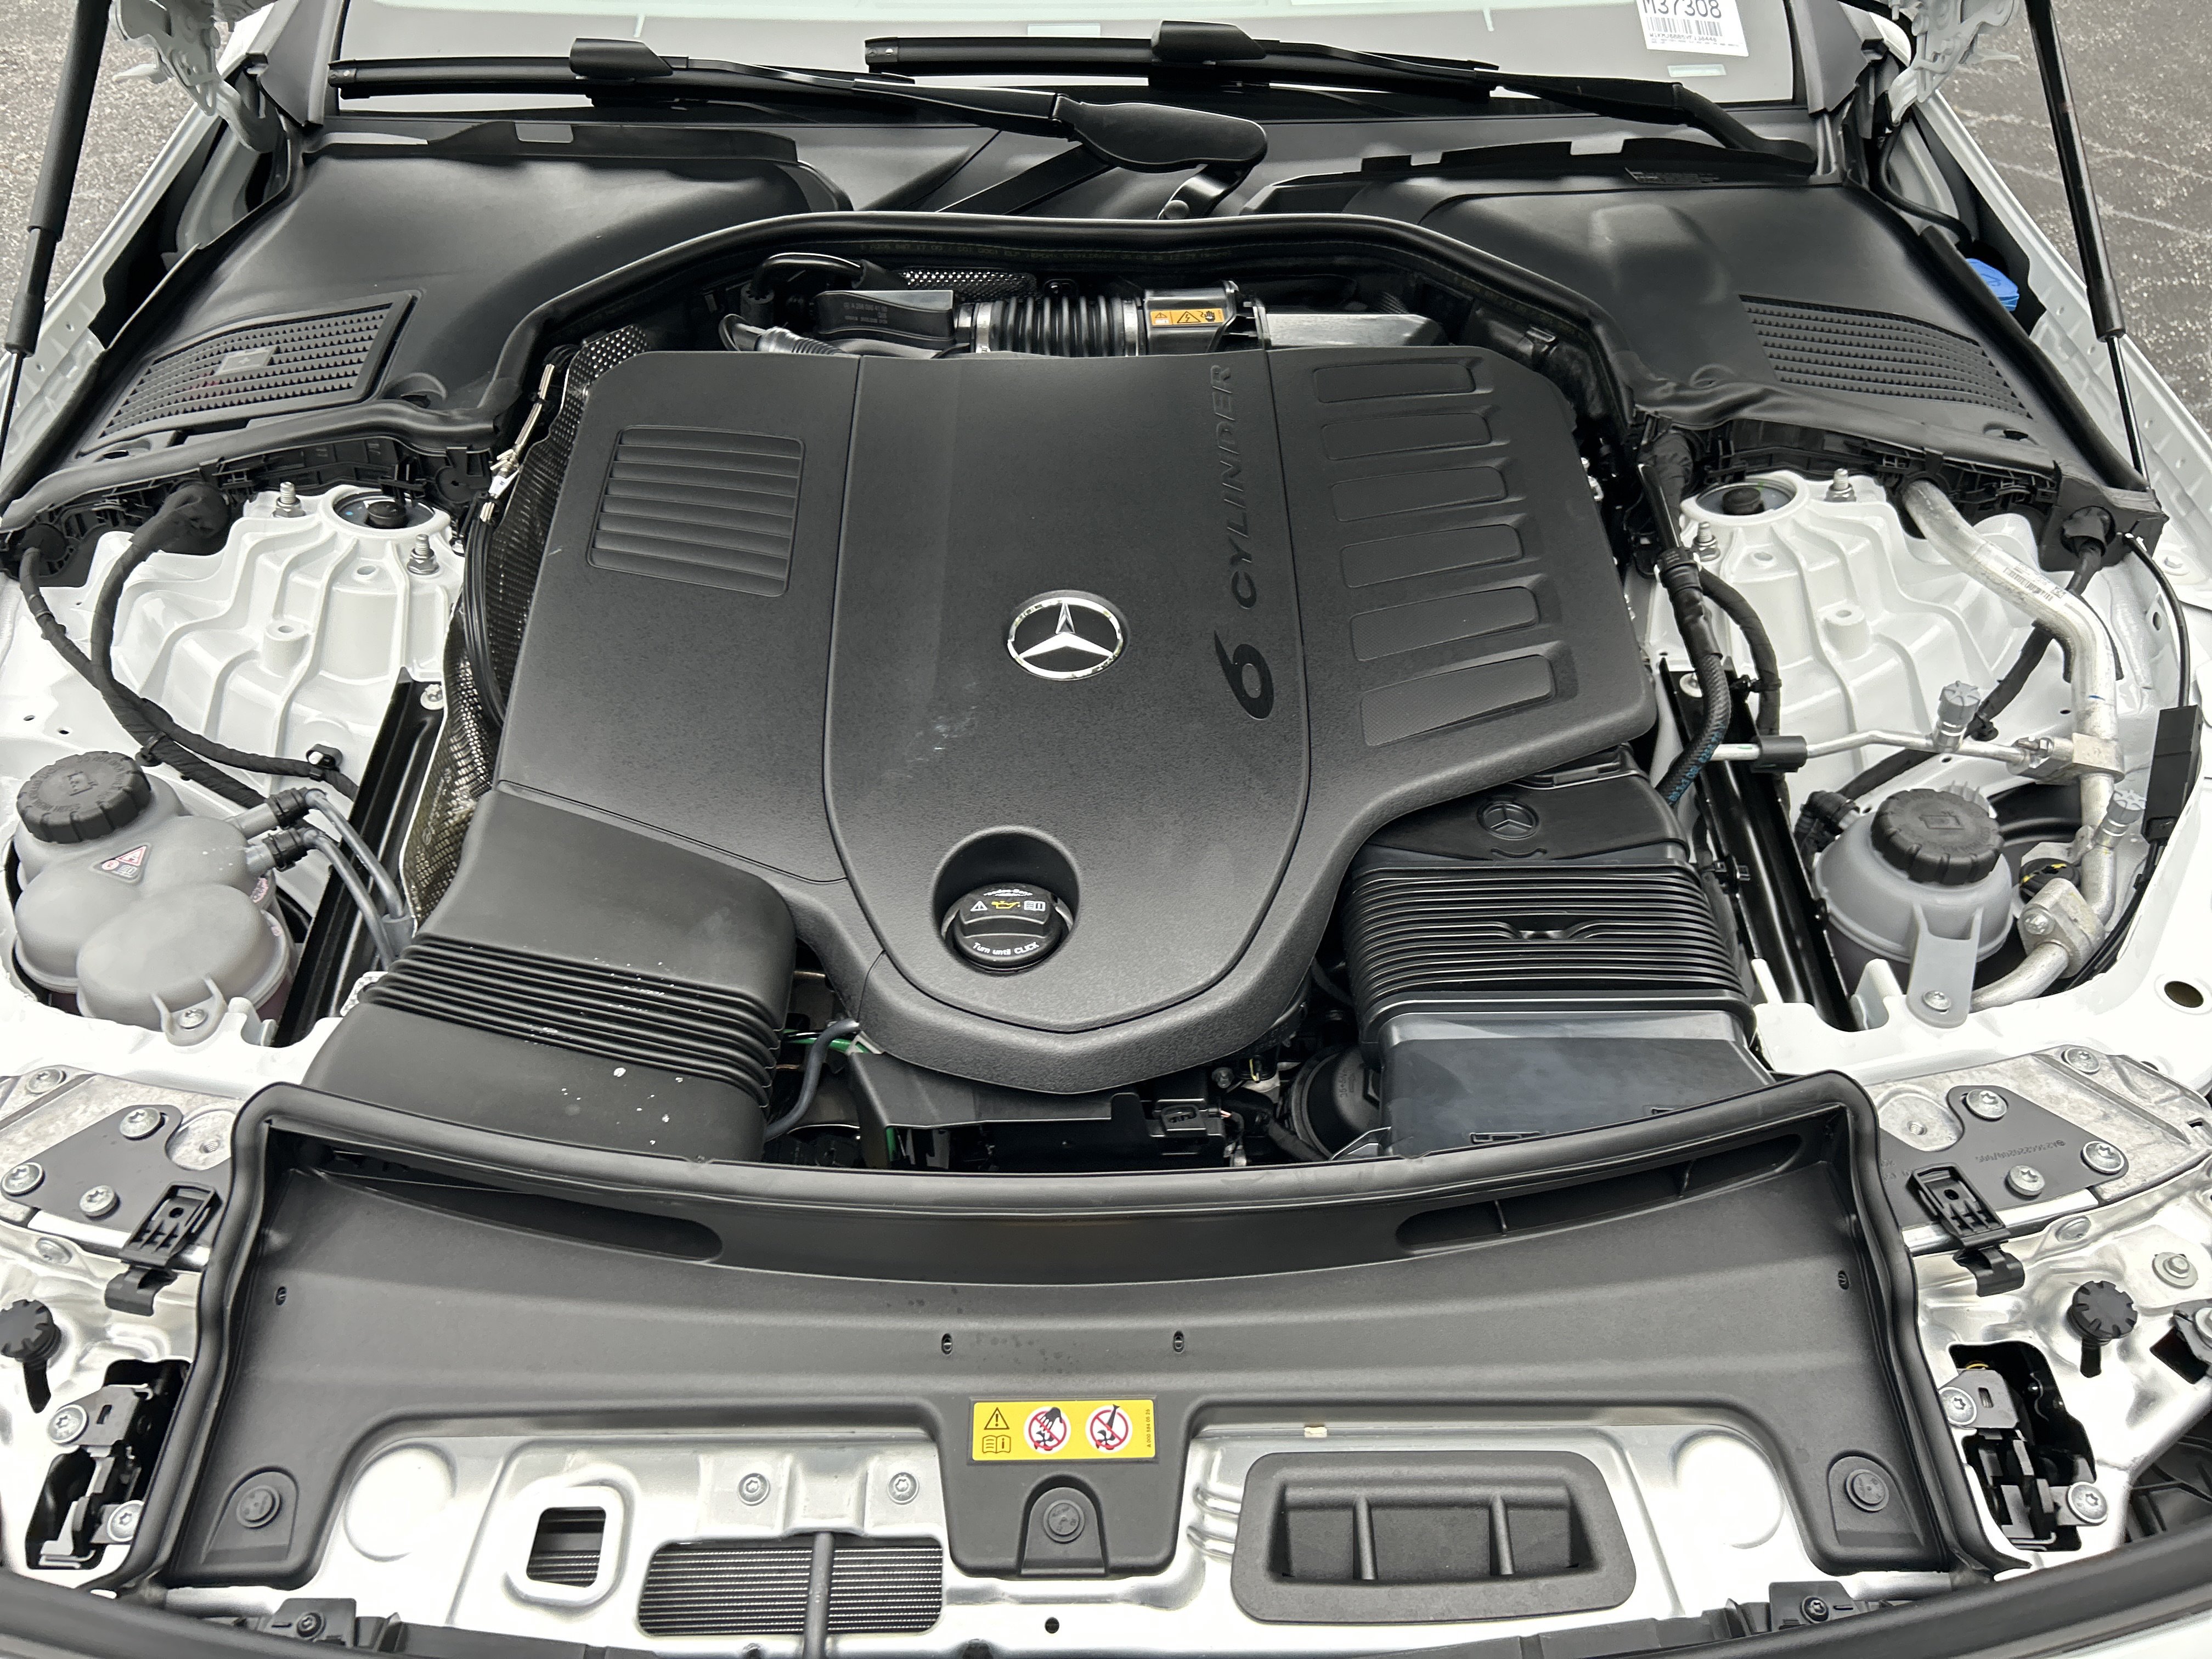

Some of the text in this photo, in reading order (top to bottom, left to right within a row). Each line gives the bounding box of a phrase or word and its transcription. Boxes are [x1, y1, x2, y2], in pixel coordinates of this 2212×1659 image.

[1643, 0, 1722, 19] M37308
[1210, 364, 1274, 720] 6 CYLINDER
[973, 943, 990, 953] Turn
[1014, 942, 1040, 954] CLICK
